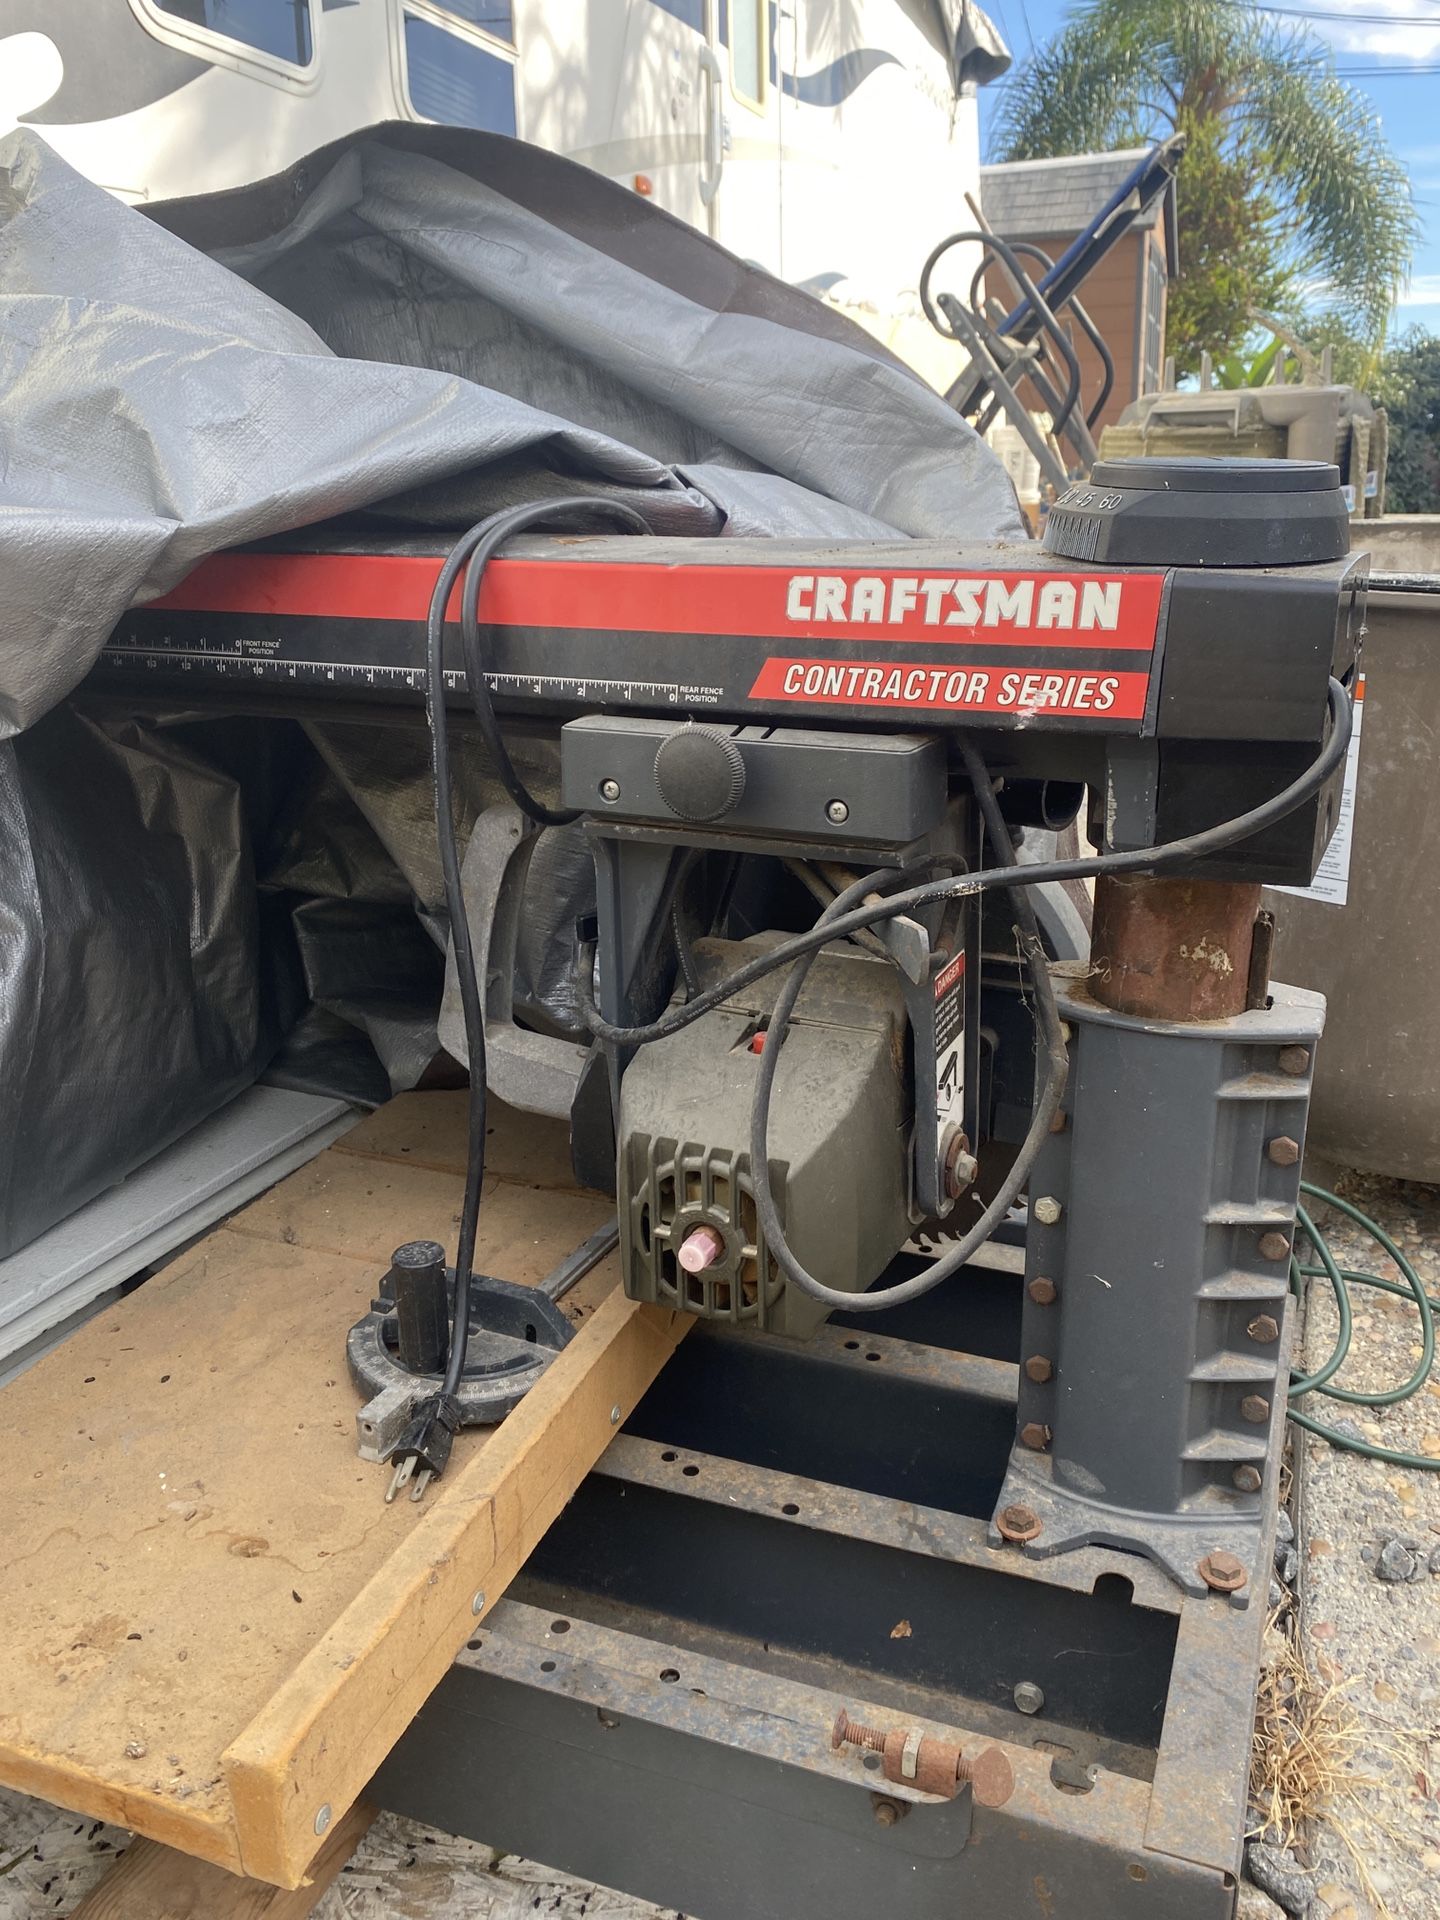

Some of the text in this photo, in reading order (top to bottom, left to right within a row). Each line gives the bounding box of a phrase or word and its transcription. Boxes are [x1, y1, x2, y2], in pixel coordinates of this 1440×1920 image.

[1075, 492, 1097, 507] 45
[1099, 494, 1122, 509] 60
[786, 575, 1123, 631] CRAFTSMAN
[243, 640, 261, 648] FRONT
[248, 647, 274, 656] POSITION
[447, 679, 453, 687] 5
[489, 681, 496, 690] 4
[533, 684, 539, 693] 3
[577, 687, 583, 696] 2
[669, 693, 675, 702] 0
[679, 685, 724, 695] REAR FENCE
[782, 664, 1120, 711] CONTRACTOR SERIES
[684, 694, 718, 703] POSITION
[937, 962, 960, 993] DANGER
